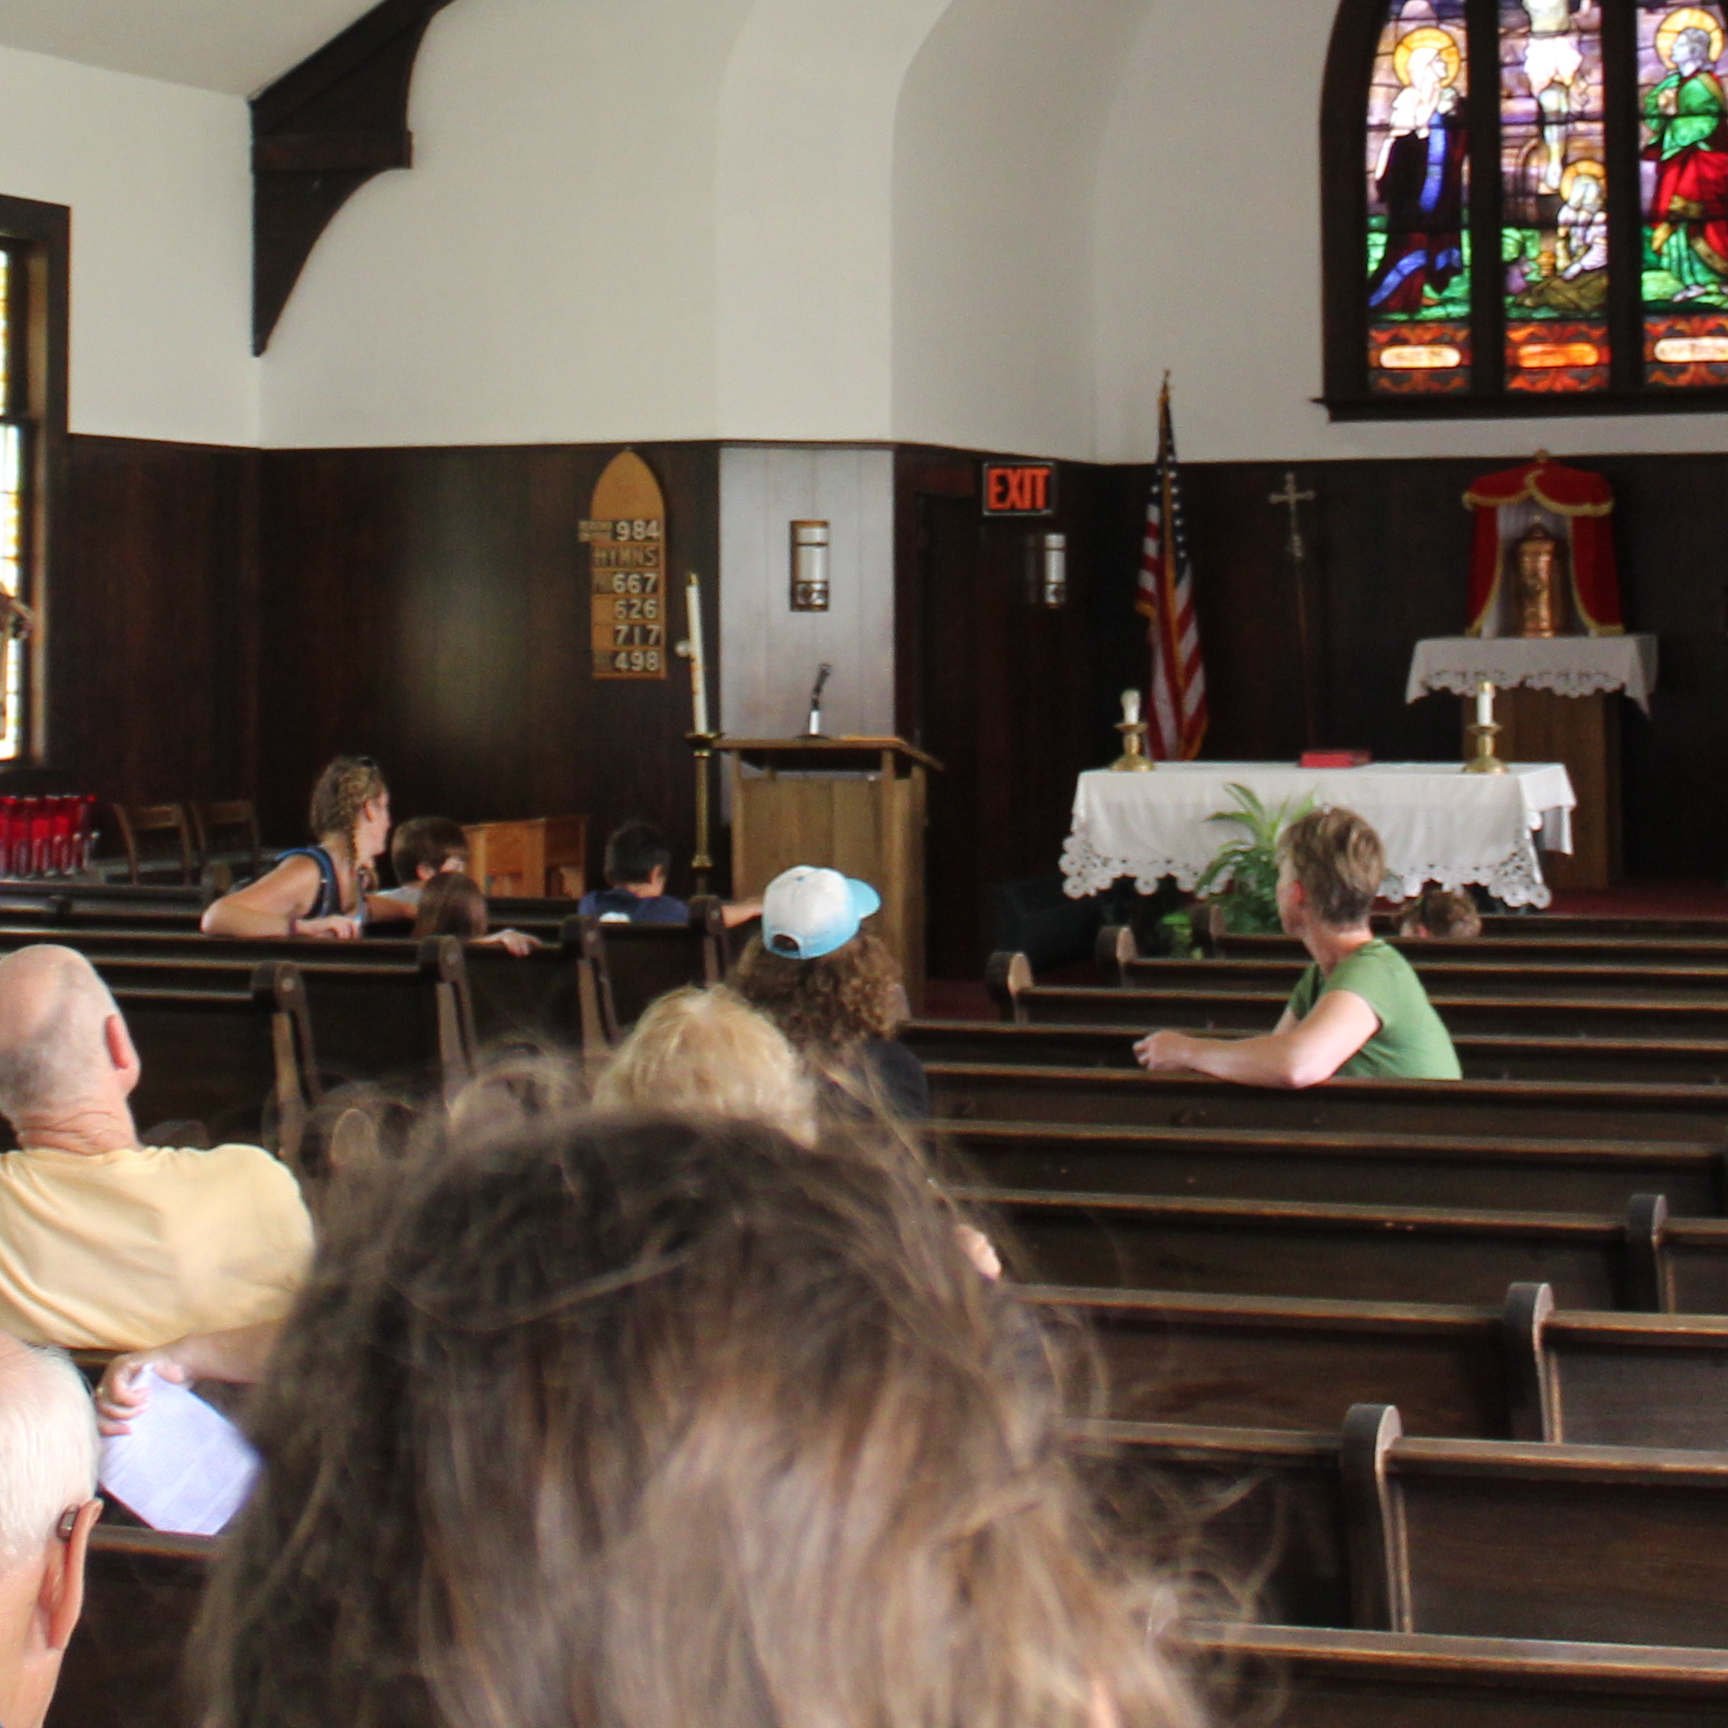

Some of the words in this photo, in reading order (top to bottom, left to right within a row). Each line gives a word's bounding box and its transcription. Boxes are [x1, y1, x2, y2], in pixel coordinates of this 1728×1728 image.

[988, 468, 1051, 510] EXIT
[616, 519, 660, 541] 984
[612, 573, 658, 593] 667
[614, 599, 658, 619] 626
[615, 625, 660, 646] 717
[615, 650, 660, 672] 498
